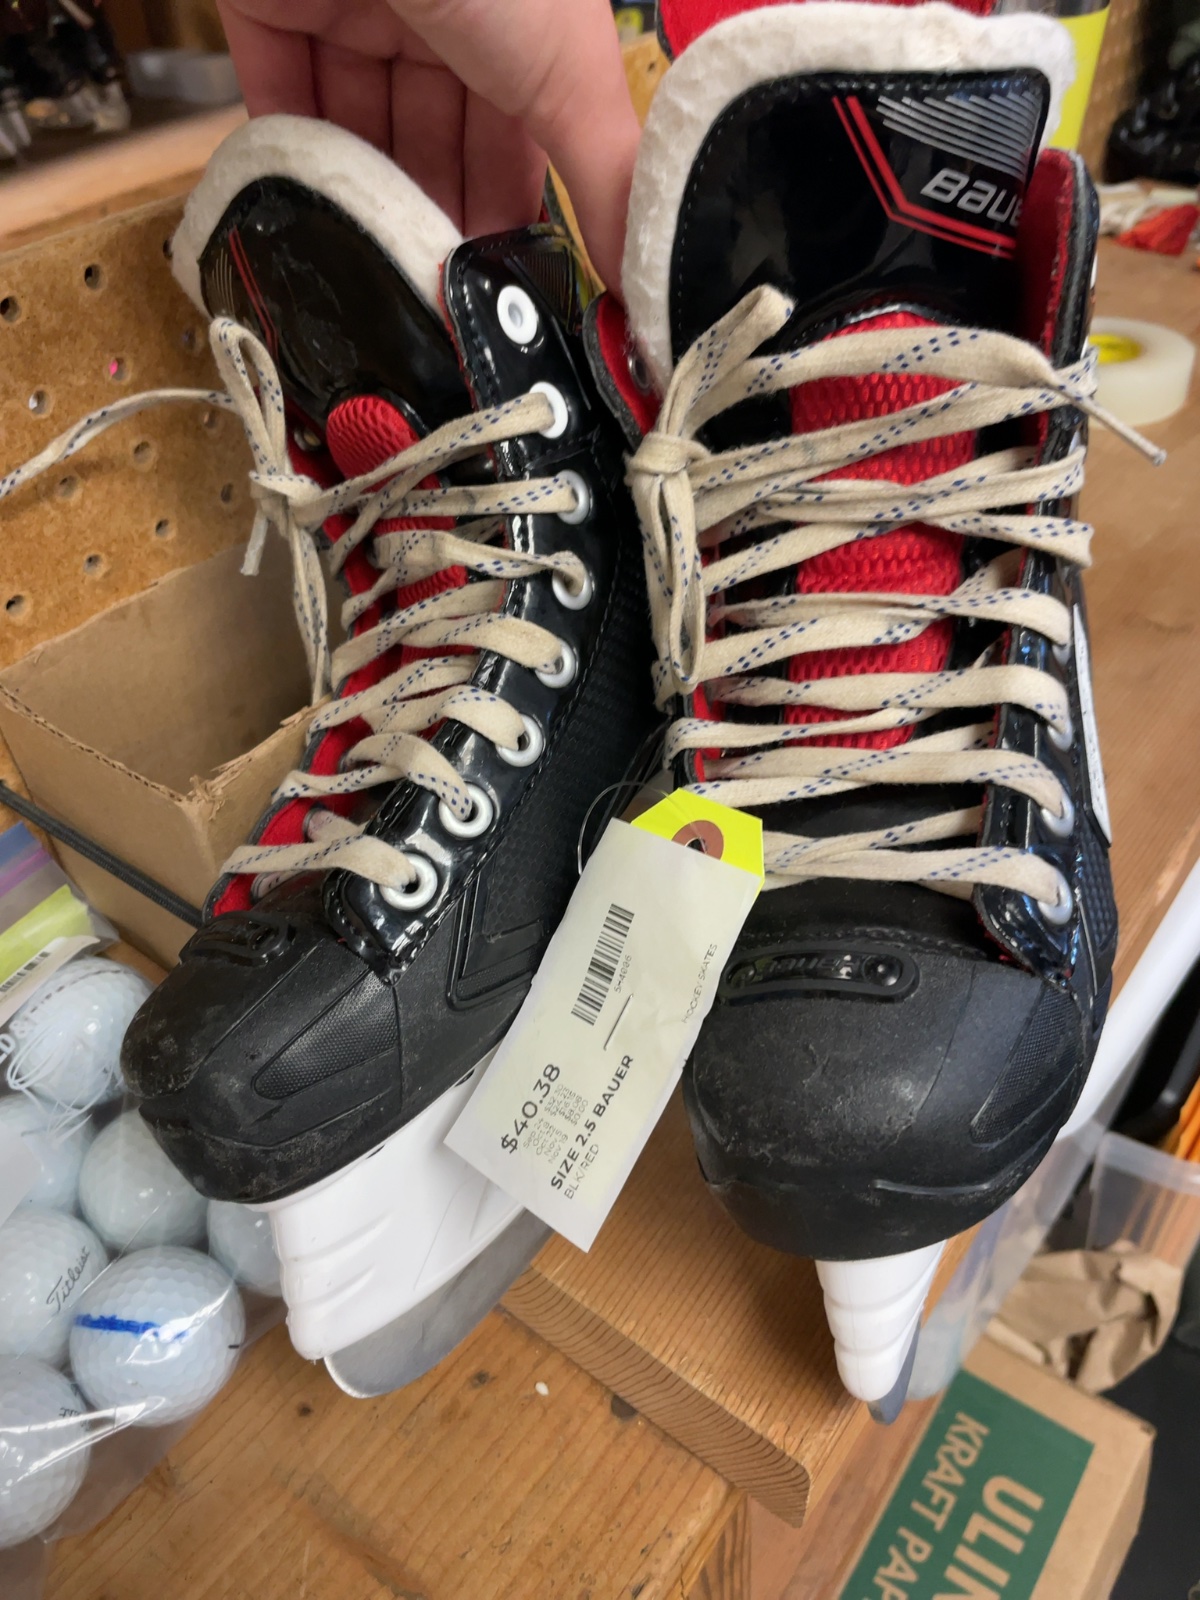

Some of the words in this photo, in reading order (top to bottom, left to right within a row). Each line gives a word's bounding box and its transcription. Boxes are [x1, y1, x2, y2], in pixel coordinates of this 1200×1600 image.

[681, 982, 702, 1023] HOCKEY
[697, 943, 717, 980] SKATES
[501, 1064, 560, 1154] $40.38
[522, 1129, 536, 1148] Sep
[532, 1115, 544, 1130] 24
[531, 1129, 544, 1146] Oct
[535, 1138, 548, 1155] Oct
[545, 1124, 556, 1137] 22
[547, 1144, 562, 1163] Nov
[558, 1132, 569, 1145] 19
[570, 1099, 588, 1125] $0.00
[551, 1147, 580, 1190] SIZE
[575, 1119, 596, 1146] 2.5
[593, 1055, 634, 1117] BAUER
[544, 1137, 557, 1155] Nov
[564, 1143, 600, 1199] BLK/RED
[46, 1246, 91, 1314] Titleist
[911, 1411, 991, 1531] KRAFT
